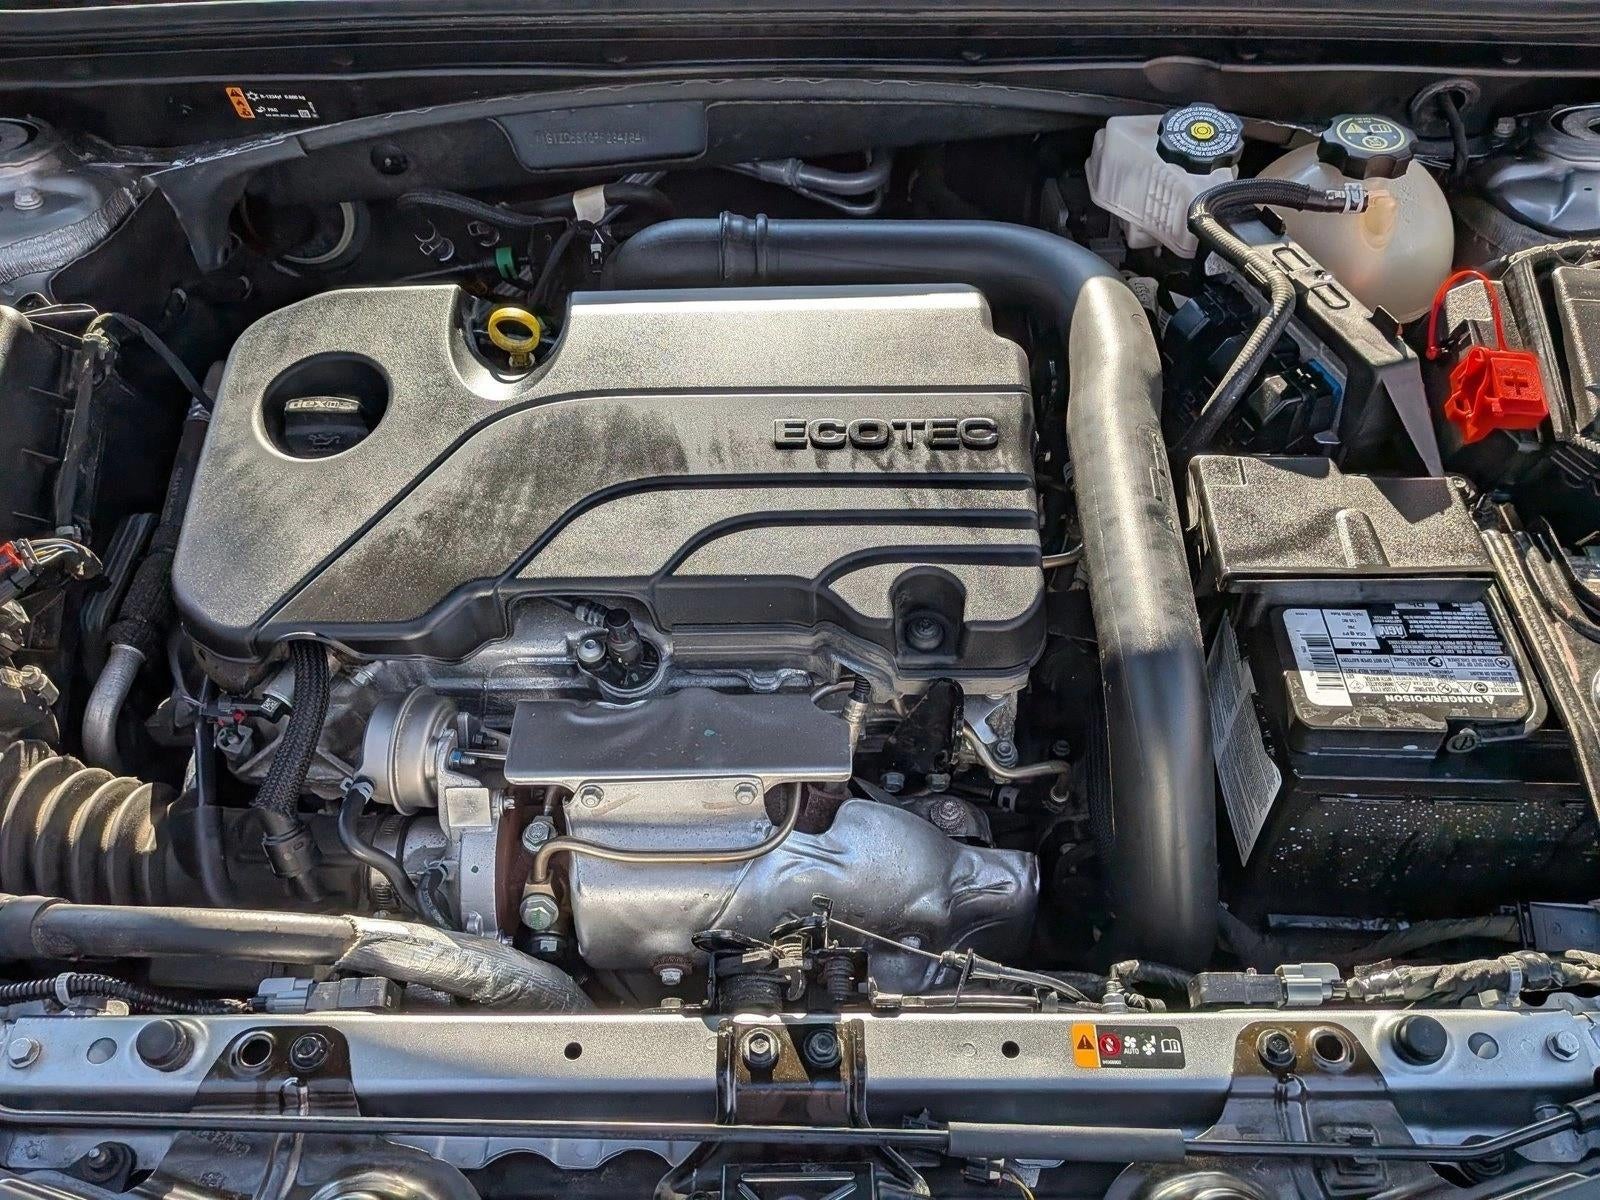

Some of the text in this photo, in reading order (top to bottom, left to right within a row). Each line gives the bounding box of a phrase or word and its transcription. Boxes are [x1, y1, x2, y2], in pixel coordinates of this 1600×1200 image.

[288, 400, 352, 409] dexos
[774, 417, 999, 450] ECOTEC
[1384, 694, 1483, 703] DANGER/POISON
